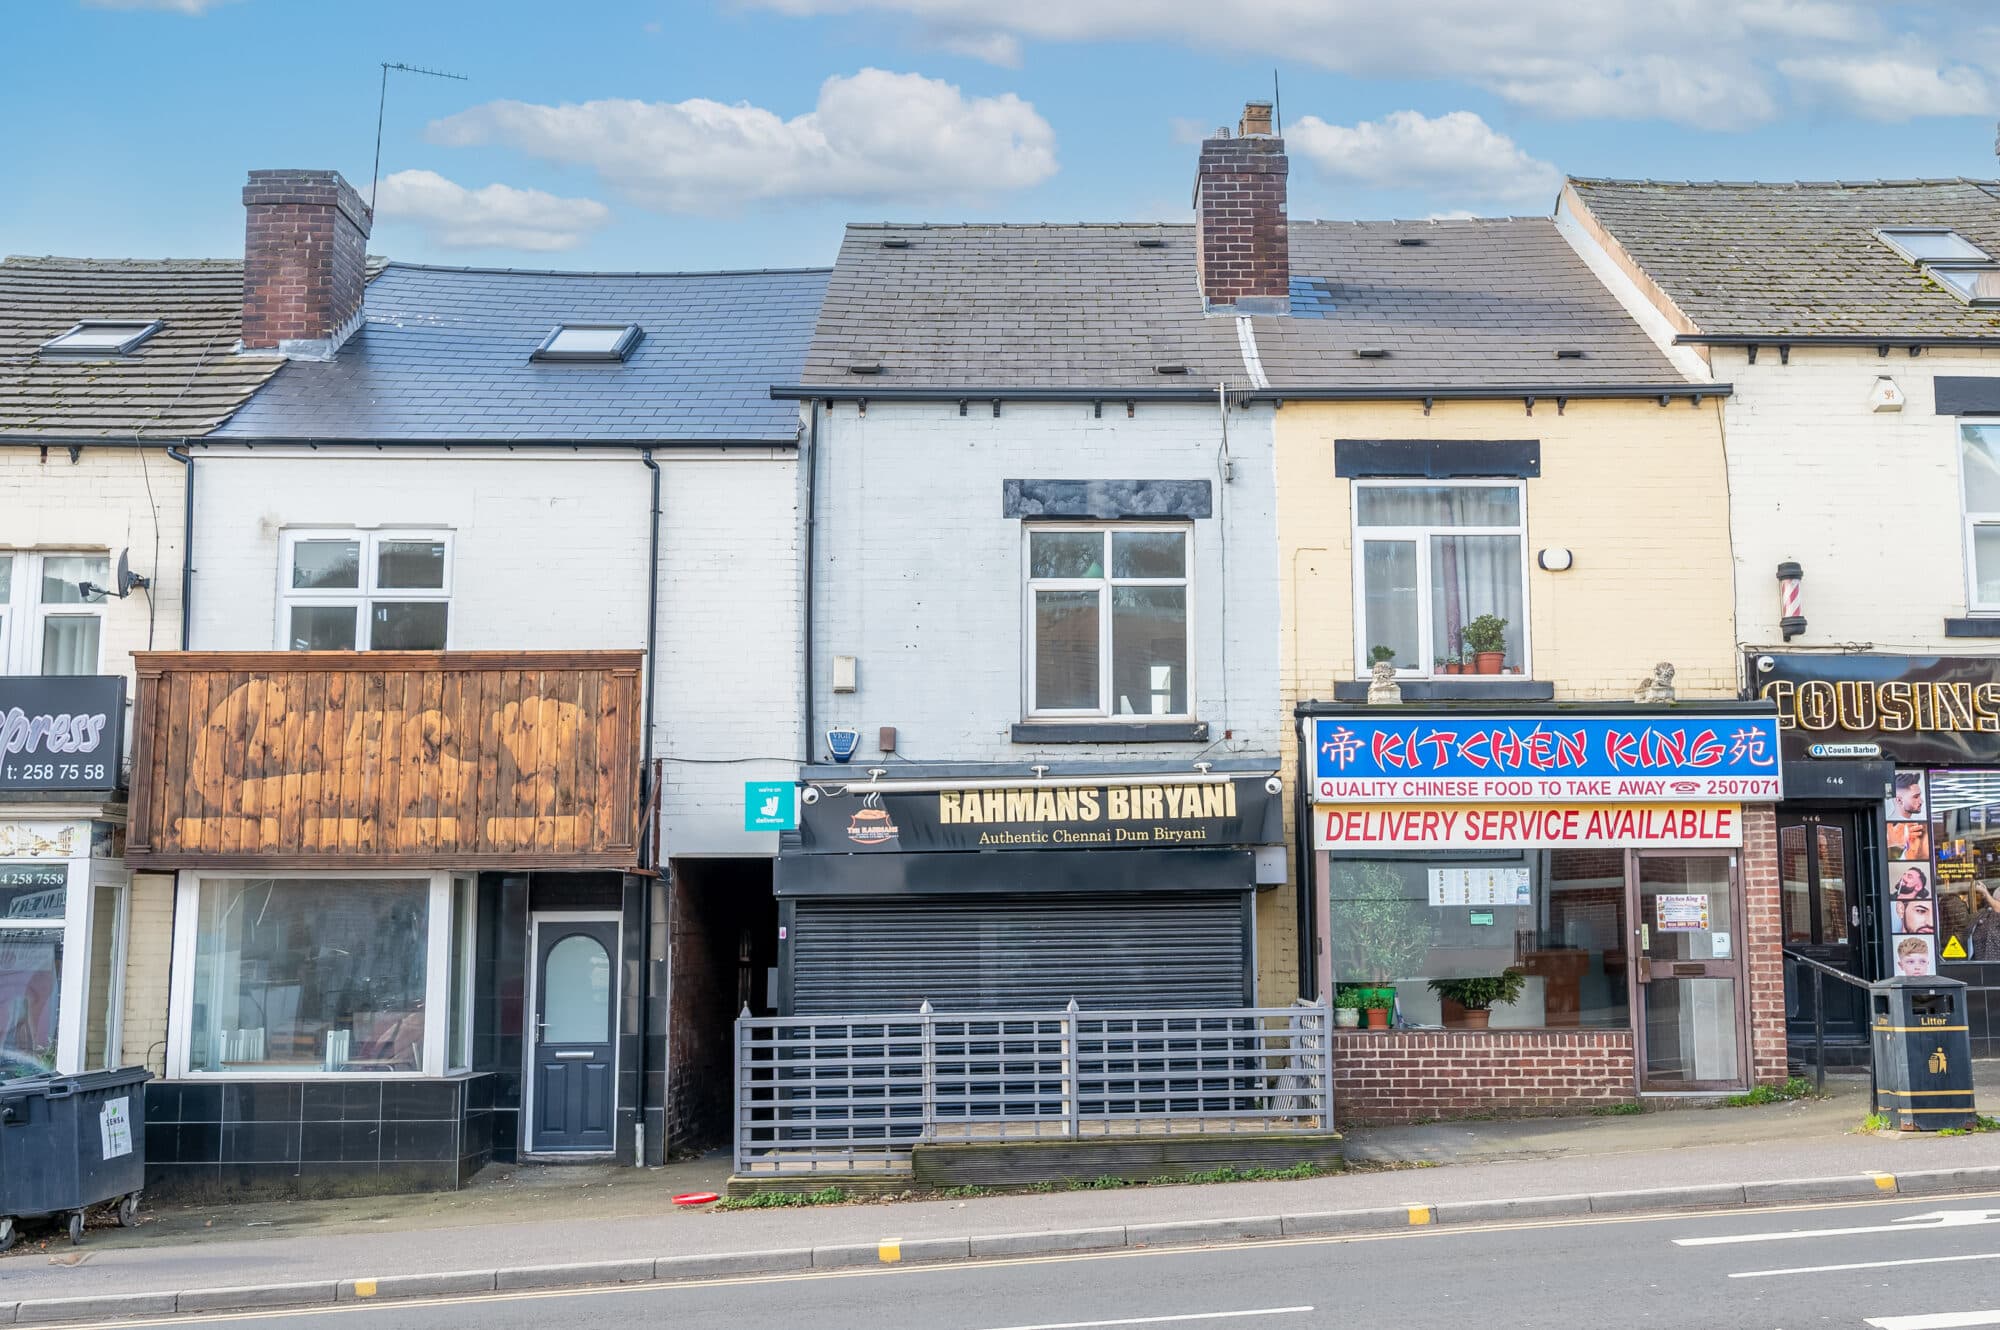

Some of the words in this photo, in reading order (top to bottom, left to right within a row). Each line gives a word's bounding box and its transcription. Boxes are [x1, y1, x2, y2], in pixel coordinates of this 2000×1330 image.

[1762, 680, 2000, 732] COUSINS
[0, 707, 106, 776] press
[1321, 726, 1365, 771] 帝
[1371, 722, 1588, 772] KITCHEN
[1605, 726, 1726, 772] KING
[1728, 726, 1775, 767] 苑
[1828, 746, 1851, 754] Cousin
[1854, 746, 1877, 754] Barber
[7, 765, 17, 780] t:
[23, 764, 53, 780] 258
[59, 764, 79, 780] 75
[84, 764, 104, 780] 58
[940, 786, 1100, 824] RAHMANS
[1107, 783, 1237, 821] BIRYANI
[1321, 781, 1397, 797] QUALITY
[1403, 781, 1478, 796] CHINESE
[1484, 781, 1533, 796] FOOD
[1538, 781, 1561, 796] TO
[1566, 781, 1611, 796] TAKE
[1618, 780, 1666, 796] AWAY
[1707, 780, 1779, 795] 2507071
[979, 831, 1048, 845] Authentic
[1053, 829, 1111, 843] Chennai
[1116, 828, 1149, 841] Dum
[1154, 826, 1206, 841] Biryani
[1325, 811, 1458, 841] DELIVERY
[1464, 810, 1580, 841] SERVICE
[1585, 809, 1732, 840] AVAILABLE
[12, 873, 33, 885] 258
[37, 873, 65, 885] 7558
[1921, 1016, 1948, 1026] Litter
